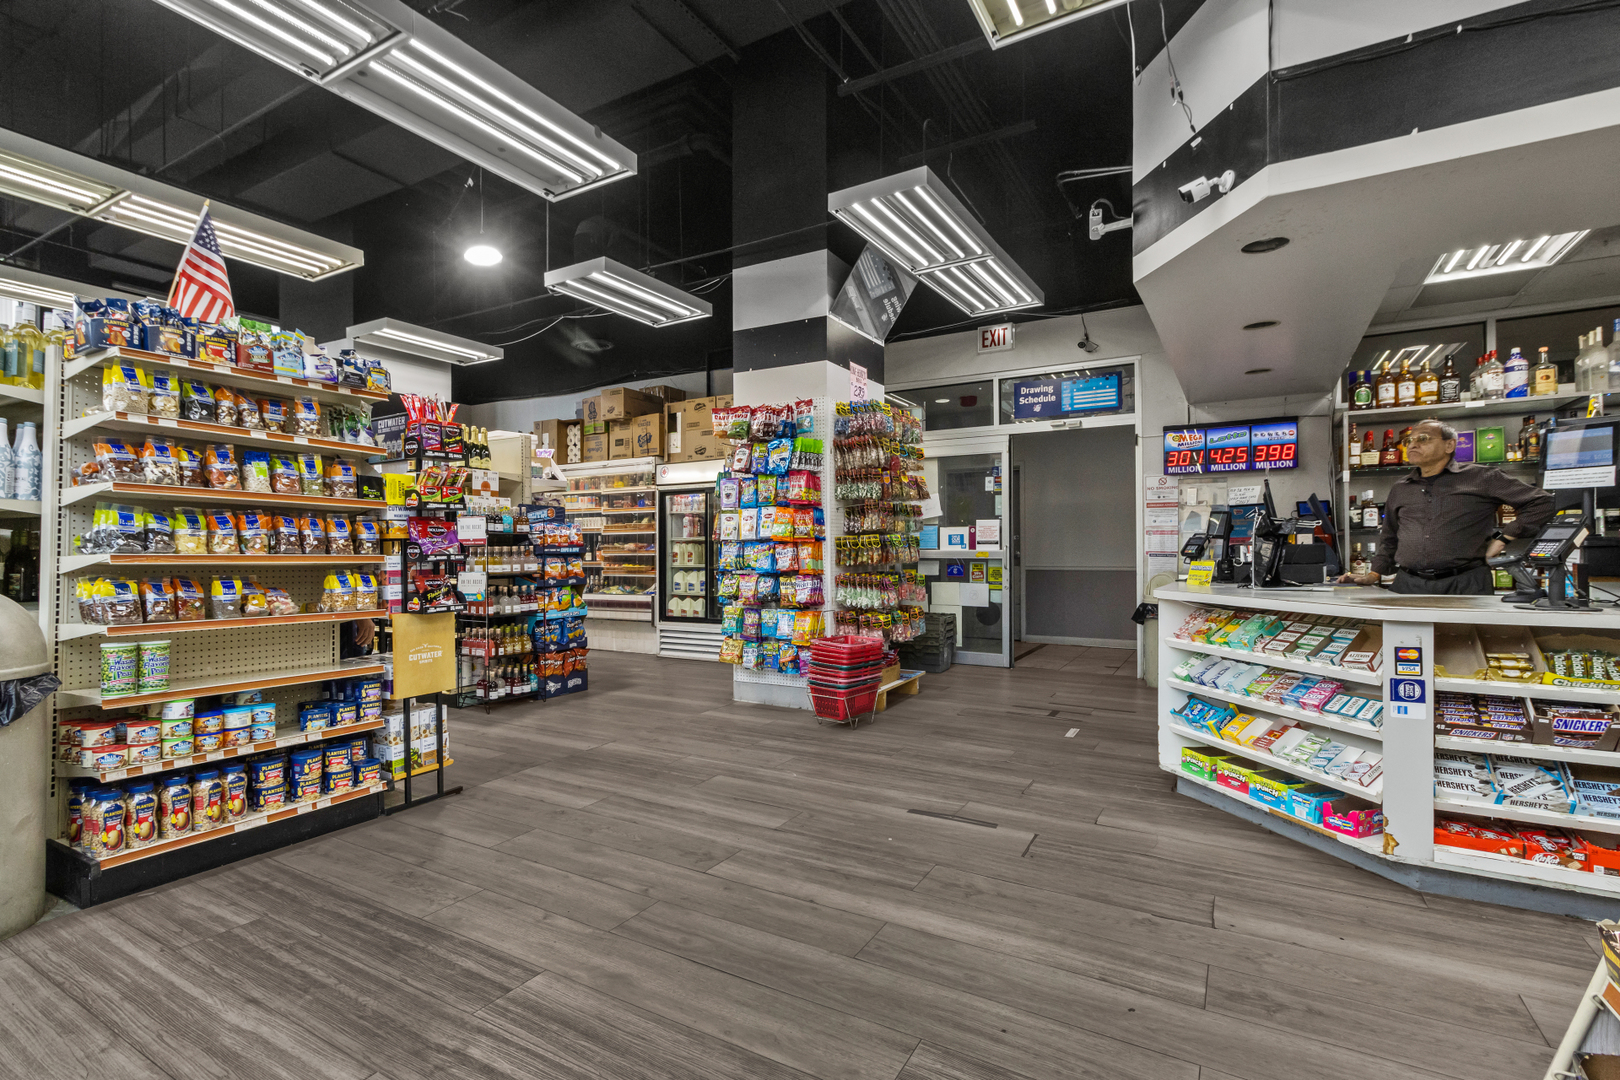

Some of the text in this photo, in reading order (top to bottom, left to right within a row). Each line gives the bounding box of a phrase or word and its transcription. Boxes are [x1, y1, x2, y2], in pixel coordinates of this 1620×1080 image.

[103, 318, 130, 328] PLANTERS
[205, 336, 228, 344] PLANTERS
[982, 328, 1008, 348] EXIT
[1020, 385, 1054, 395] Drawing
[1019, 394, 1056, 404] Schedule
[378, 416, 406, 428] CUTWATER
[1179, 434, 1203, 442] MEGA
[1209, 432, 1247, 444] Lotto
[1210, 447, 1248, 463] 4.25
[1254, 444, 1296, 461] 398
[1210, 463, 1246, 471] MILLION
[1256, 460, 1293, 468] MILLION
[1168, 466, 1201, 474] MILLION
[409, 650, 442, 661] CUTWATER
[1553, 678, 1620, 690] Chuckles
[1553, 719, 1611, 732] SNICKERS
[1452, 729, 1495, 738] SNICKERS
[262, 762, 283, 771] PLANTERS
[1187, 756, 1203, 767] PUNCH
[361, 764, 380, 772] PLANTERS
[1434, 766, 1472, 778] HERSHEY'S
[1224, 770, 1246, 782] PUNCH
[1437, 780, 1476, 792] HERSHEY'S
[1508, 778, 1540, 794] HERSHEY'S
[1574, 780, 1612, 790] HERSHEY'S
[262, 787, 285, 795] PLANTERS
[1256, 784, 1279, 797] PUNCH
[1510, 800, 1549, 809] HERSHEY'S
